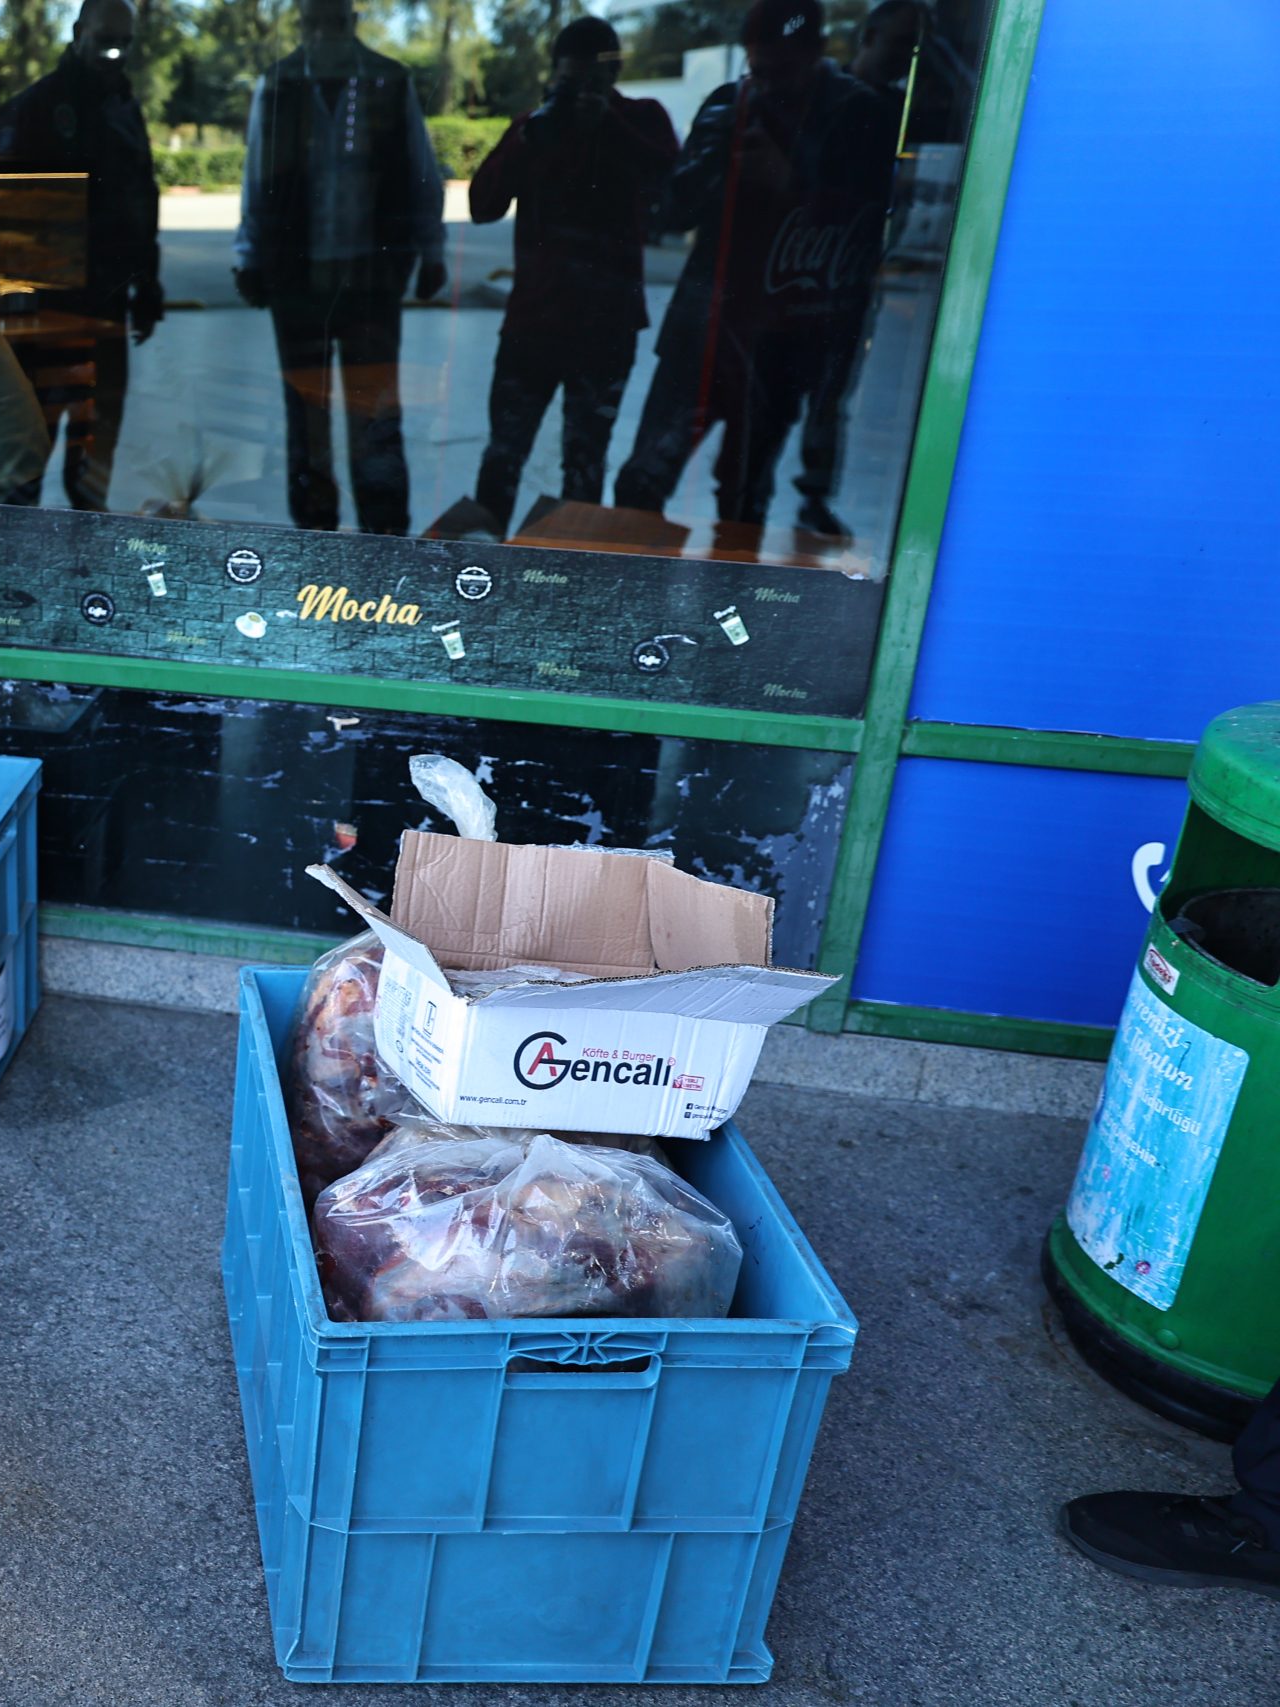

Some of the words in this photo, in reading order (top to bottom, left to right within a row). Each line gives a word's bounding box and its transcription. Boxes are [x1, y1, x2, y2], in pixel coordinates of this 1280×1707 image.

[127, 538, 167, 554] Mocha
[522, 569, 569, 584] Mocha
[754, 587, 801, 603] Mocha
[297, 584, 423, 626] Mocha
[537, 661, 581, 677] Mocha
[762, 683, 808, 699] Mocha
[582, 1047, 609, 1060] Köfte
[611, 1050, 619, 1060] &
[622, 1050, 656, 1063] Burger
[1141, 1082, 1203, 1137] üdürlüğü
